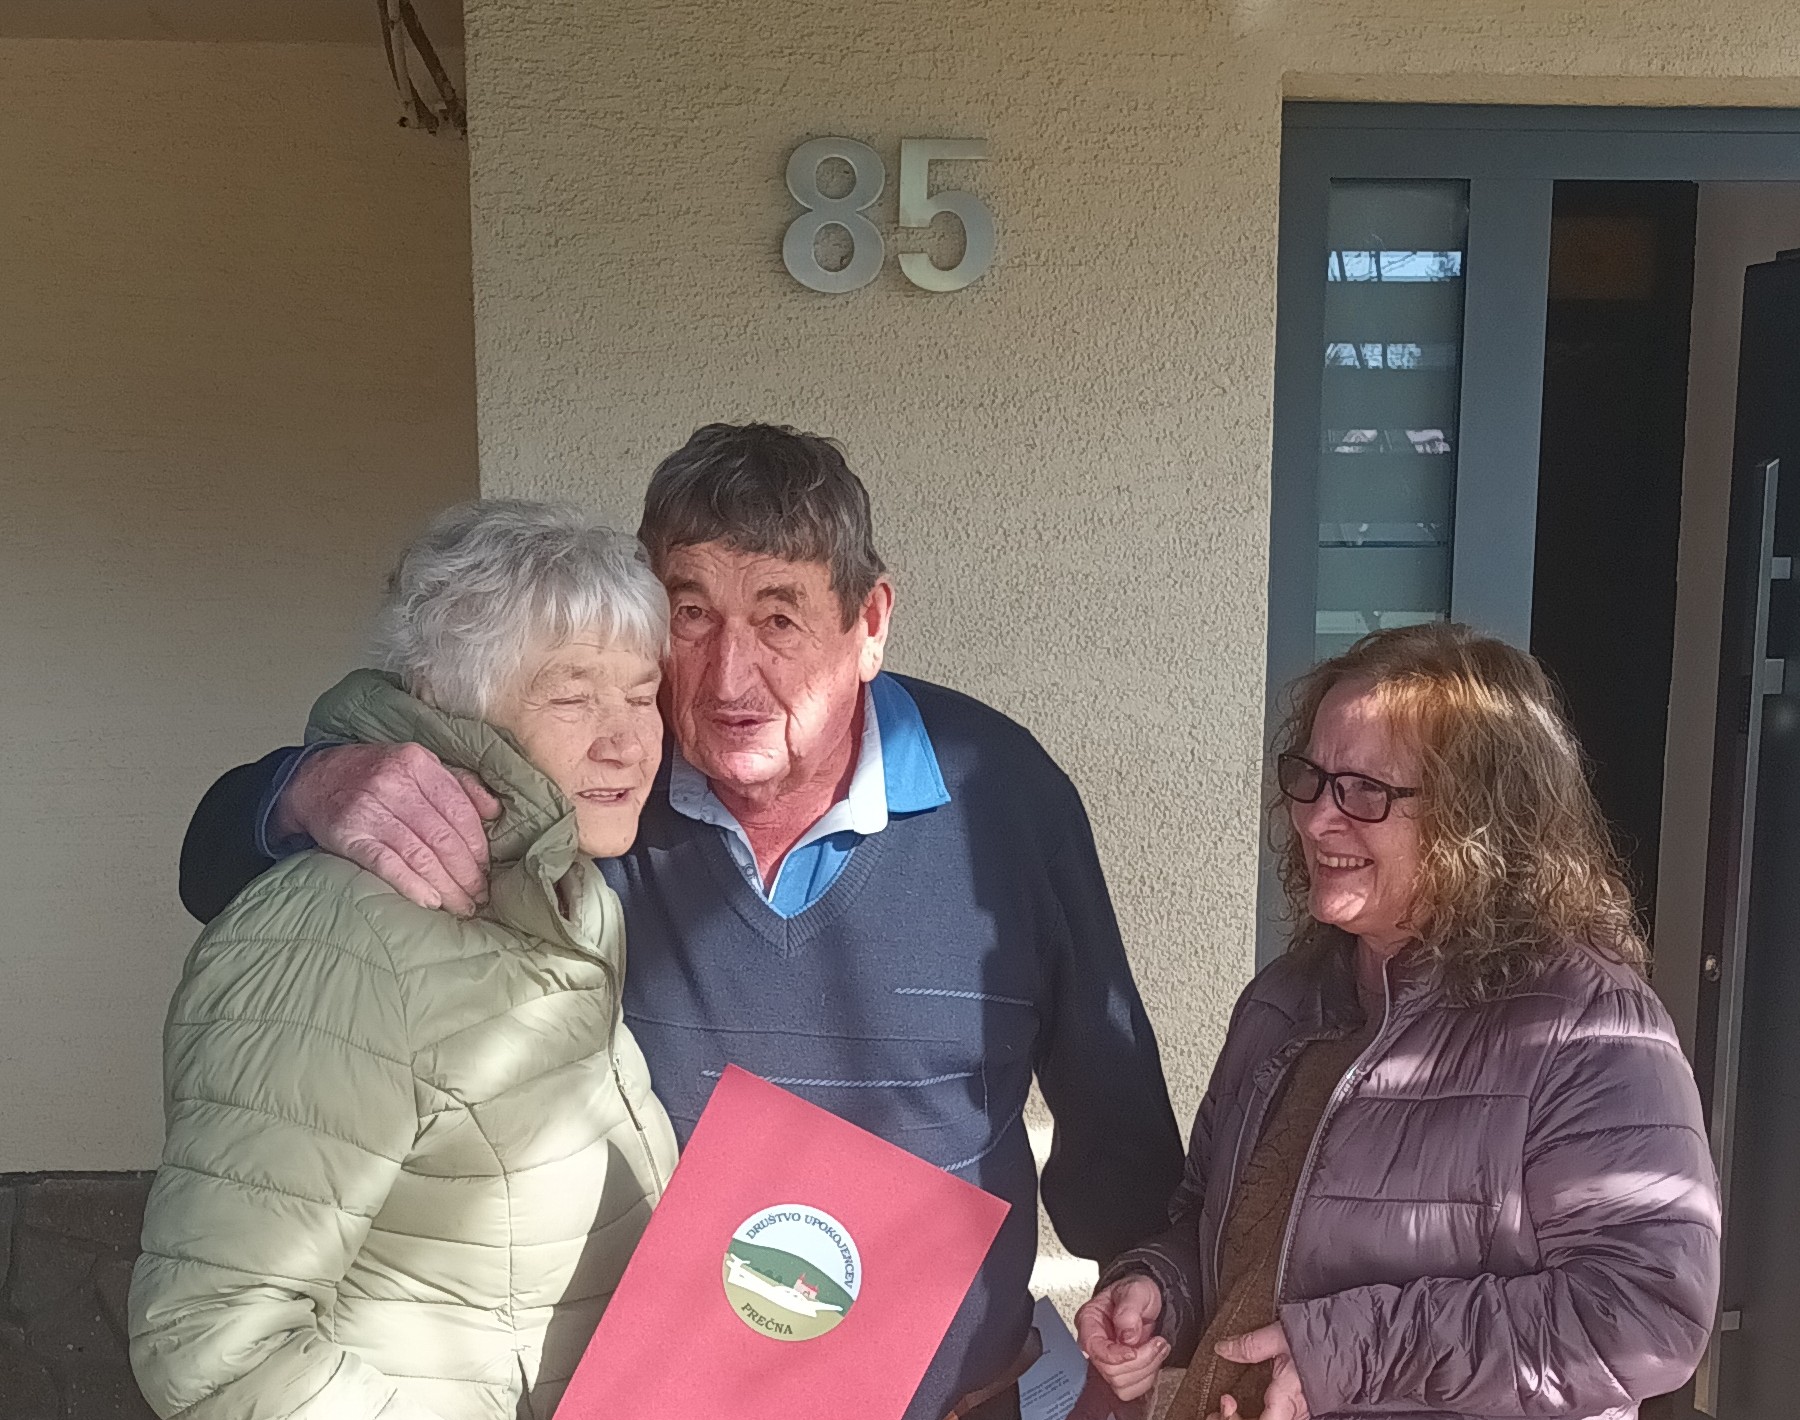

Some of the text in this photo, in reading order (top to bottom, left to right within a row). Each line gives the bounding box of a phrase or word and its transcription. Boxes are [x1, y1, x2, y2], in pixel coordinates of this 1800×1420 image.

[782, 136, 995, 293] 85
[746, 1212, 855, 1289] DRUŠTVO UPOKOJENCEV
[741, 1303, 793, 1334] PREČNA
